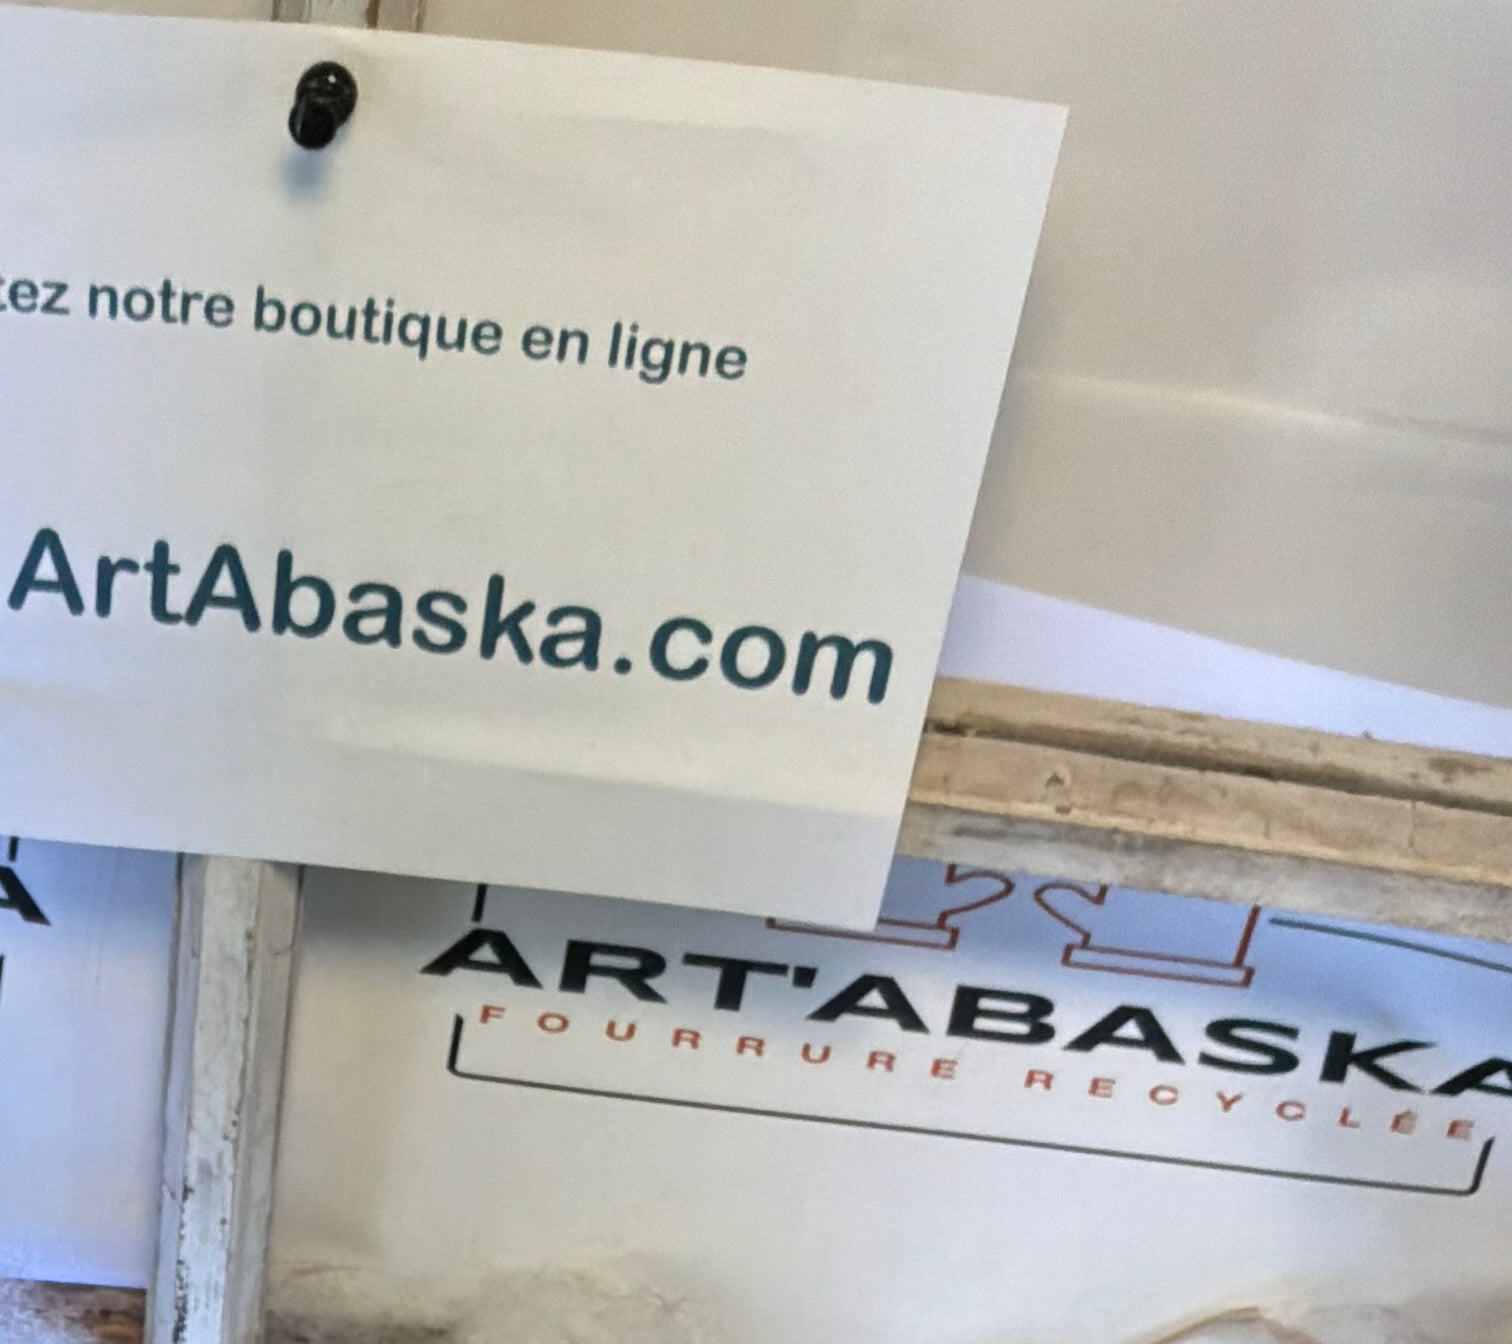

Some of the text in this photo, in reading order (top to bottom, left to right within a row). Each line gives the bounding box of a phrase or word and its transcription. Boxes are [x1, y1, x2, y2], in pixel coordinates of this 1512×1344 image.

[88, 279, 235, 329] notre
[254, 287, 503, 360] boutique
[521, 322, 589, 365] en
[608, 322, 747, 384] ligne
[421, 930, 1512, 1097] ART'ABASKA
[481, 1006, 1476, 1140] FOURRURE RECYCLÉE
